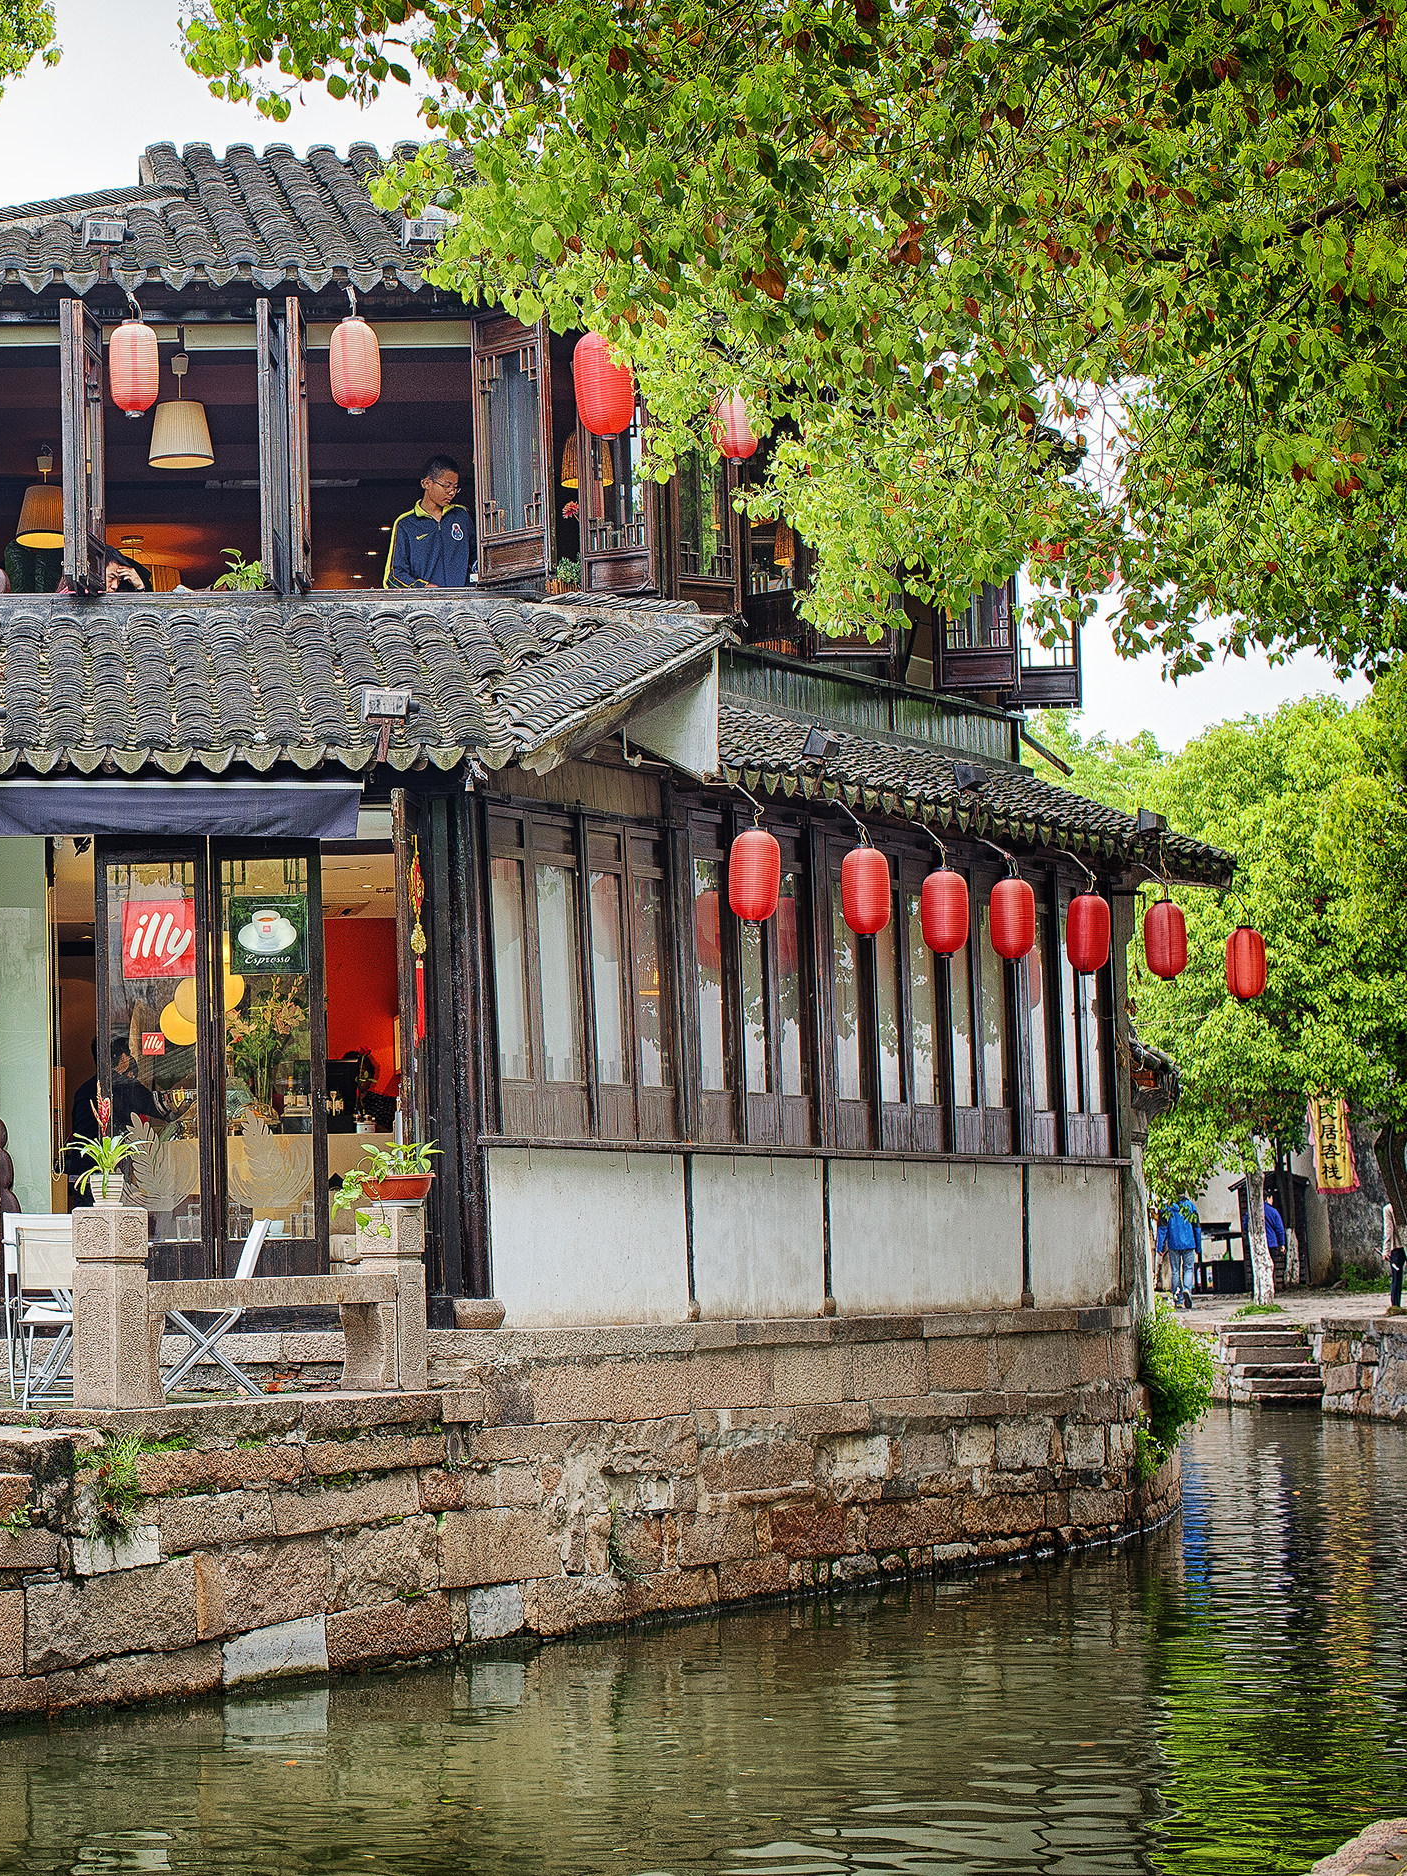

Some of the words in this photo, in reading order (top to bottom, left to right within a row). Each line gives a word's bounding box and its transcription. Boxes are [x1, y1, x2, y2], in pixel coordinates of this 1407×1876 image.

[129, 912, 193, 967] illy
[245, 953, 291, 966] Espresso
[144, 1035, 163, 1053] illy
